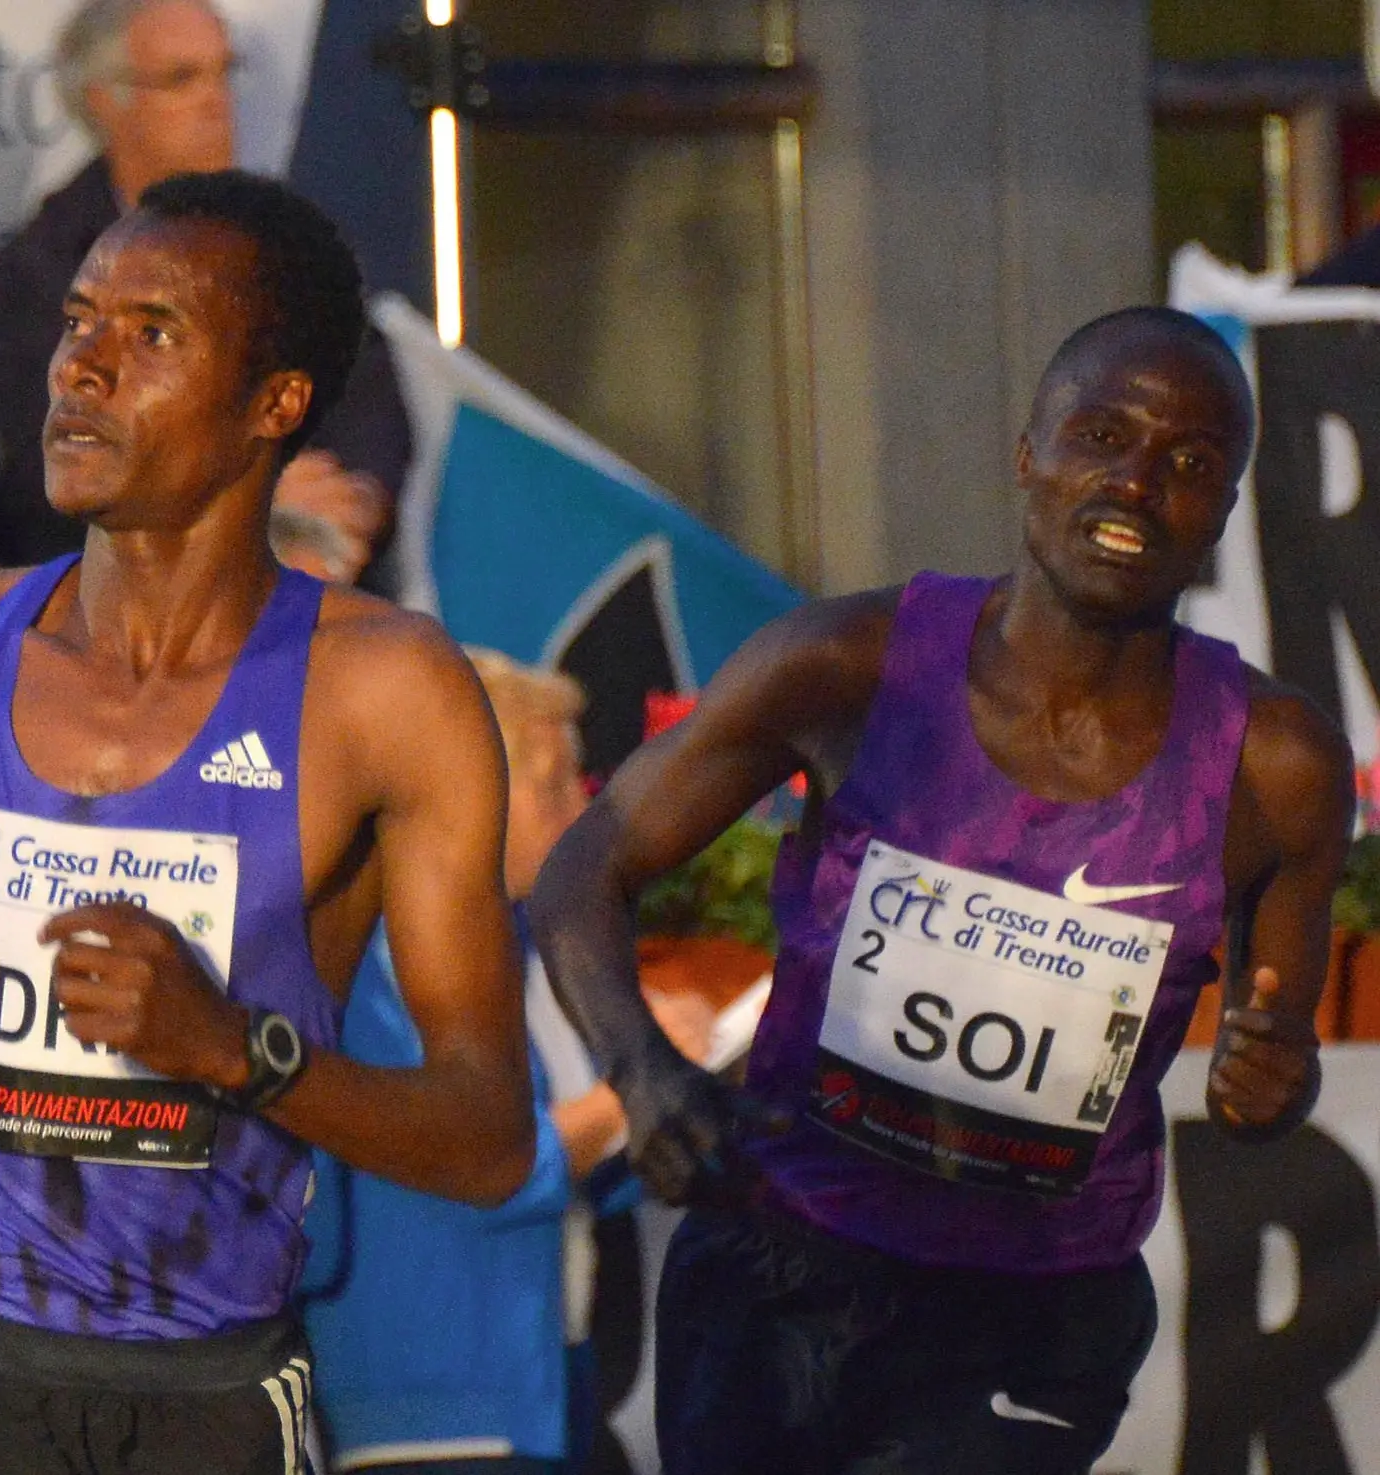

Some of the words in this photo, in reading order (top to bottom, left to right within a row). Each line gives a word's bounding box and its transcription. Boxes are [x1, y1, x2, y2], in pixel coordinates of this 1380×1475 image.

[200, 763, 283, 790] adidas
[11, 835, 98, 877] Cassa
[109, 847, 218, 885] Rurale
[7, 871, 33, 901] di
[852, 928, 886, 974] 2
[954, 923, 984, 950] di
[993, 930, 1085, 979] Trento
[964, 892, 1048, 937] Cassa
[1055, 917, 1151, 965] Rurale
[893, 991, 1056, 1093] SOI
[23, 1120, 40, 1135] da
[42, 1124, 112, 1143] percorrere
